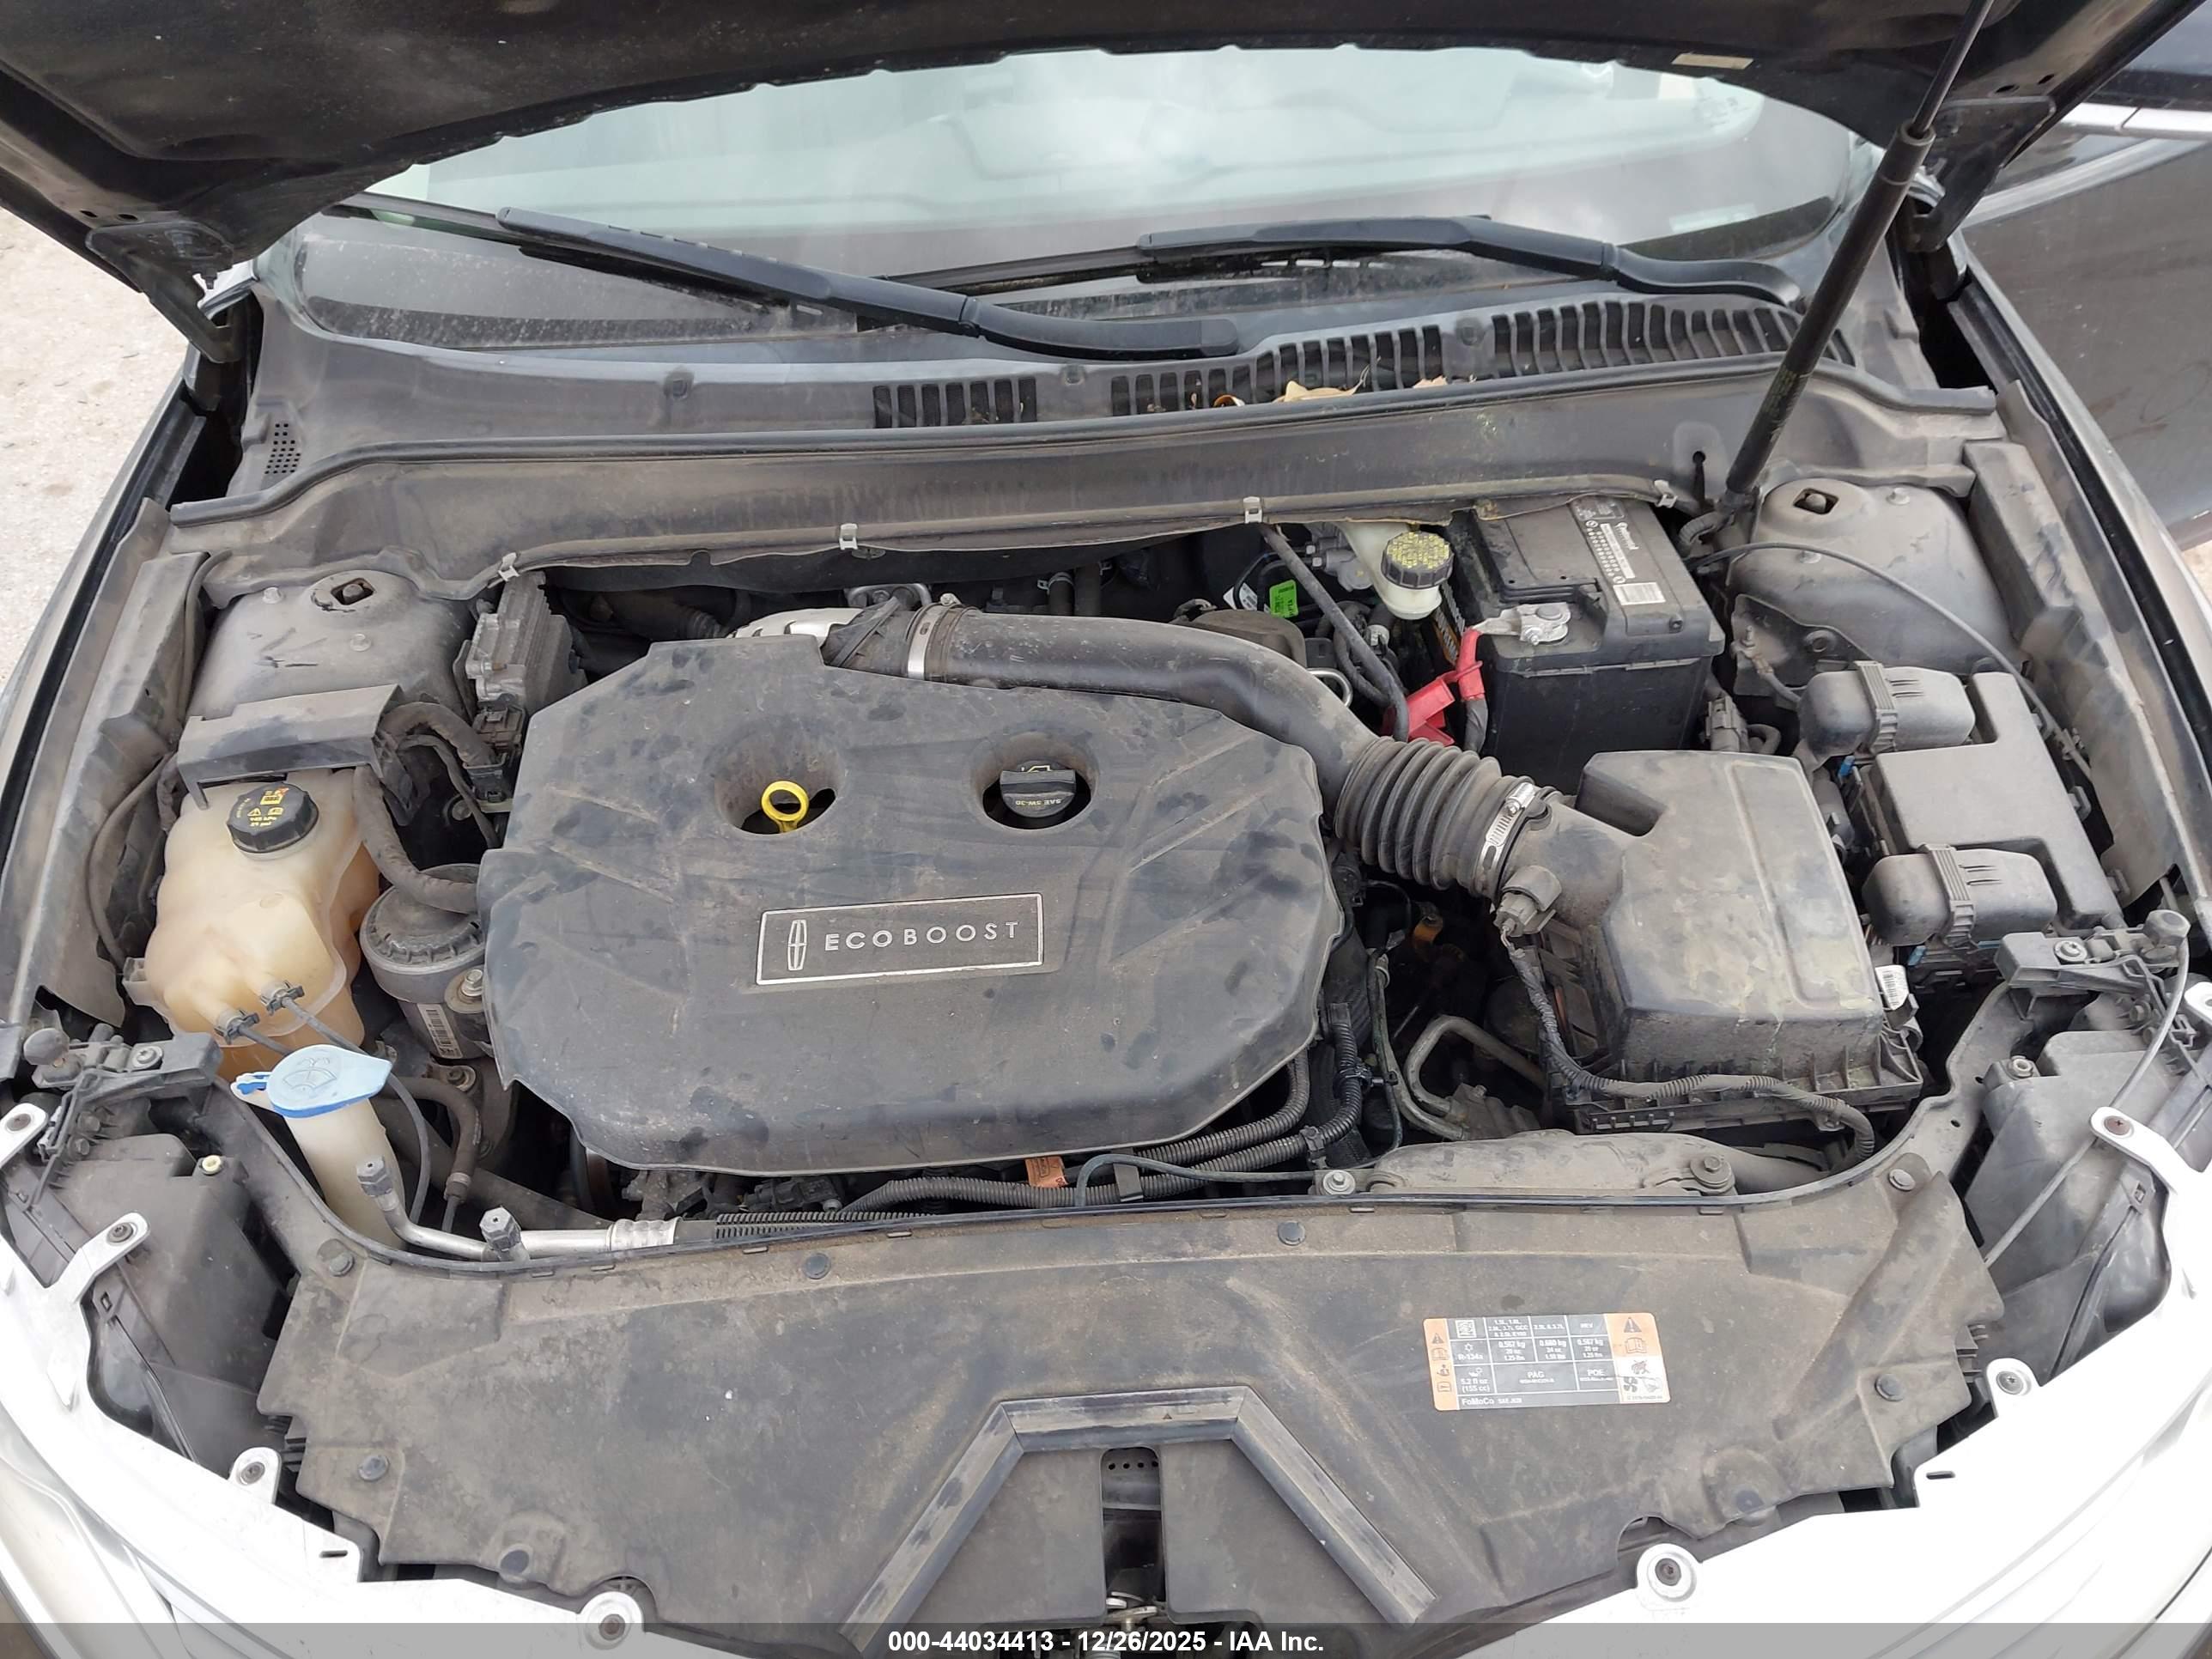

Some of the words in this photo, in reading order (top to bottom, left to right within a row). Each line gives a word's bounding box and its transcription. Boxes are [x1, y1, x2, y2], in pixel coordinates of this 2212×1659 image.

[824, 921, 1019, 951] ECOBOOST
[1558, 1339, 1567, 1347] kg
[1527, 1370, 1545, 1379] PAG
[1462, 1397, 1495, 1406] FoMoCo
